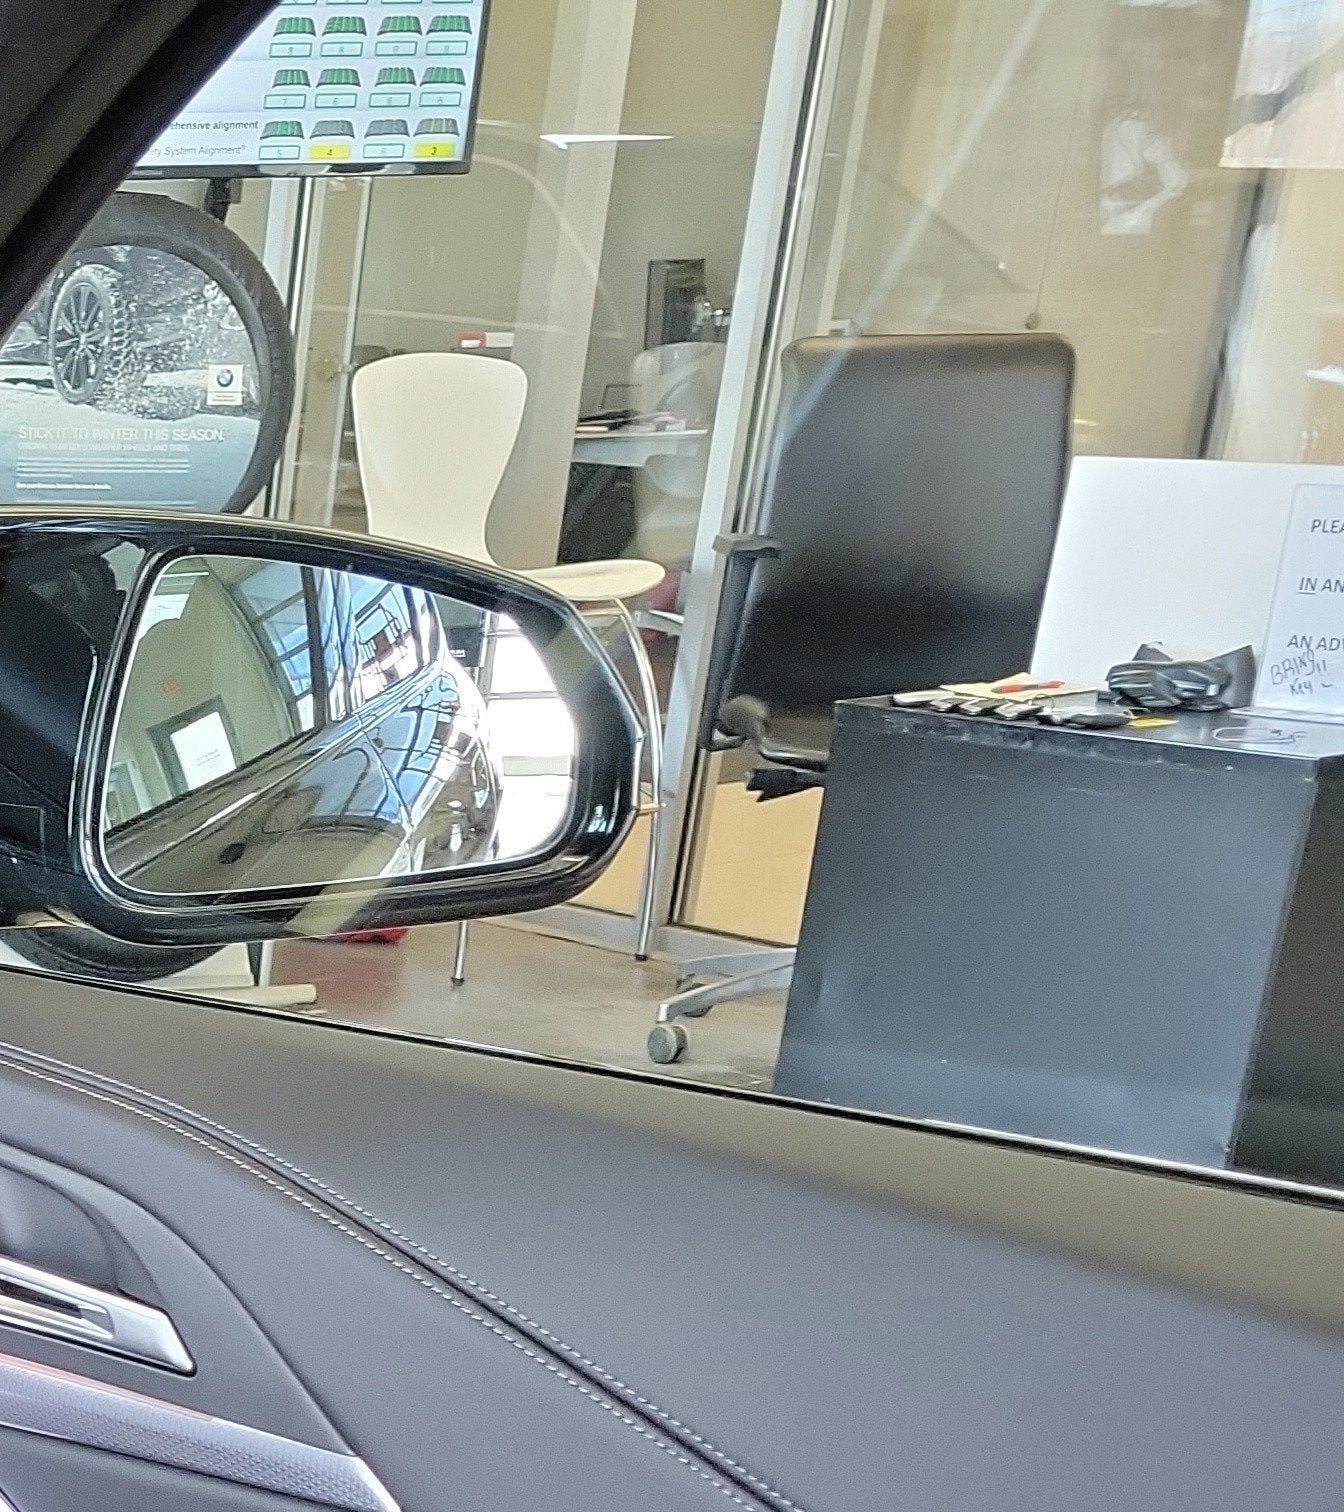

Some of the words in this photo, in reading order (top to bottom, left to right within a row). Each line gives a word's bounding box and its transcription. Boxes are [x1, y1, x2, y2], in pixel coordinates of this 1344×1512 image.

[213, 120, 259, 133] alignment
[143, 427, 169, 440] THIS
[171, 428, 225, 441] SEASON.
[1299, 577, 1318, 591] IN
[1287, 634, 1312, 649] AN
[1316, 637, 1344, 651] AD
